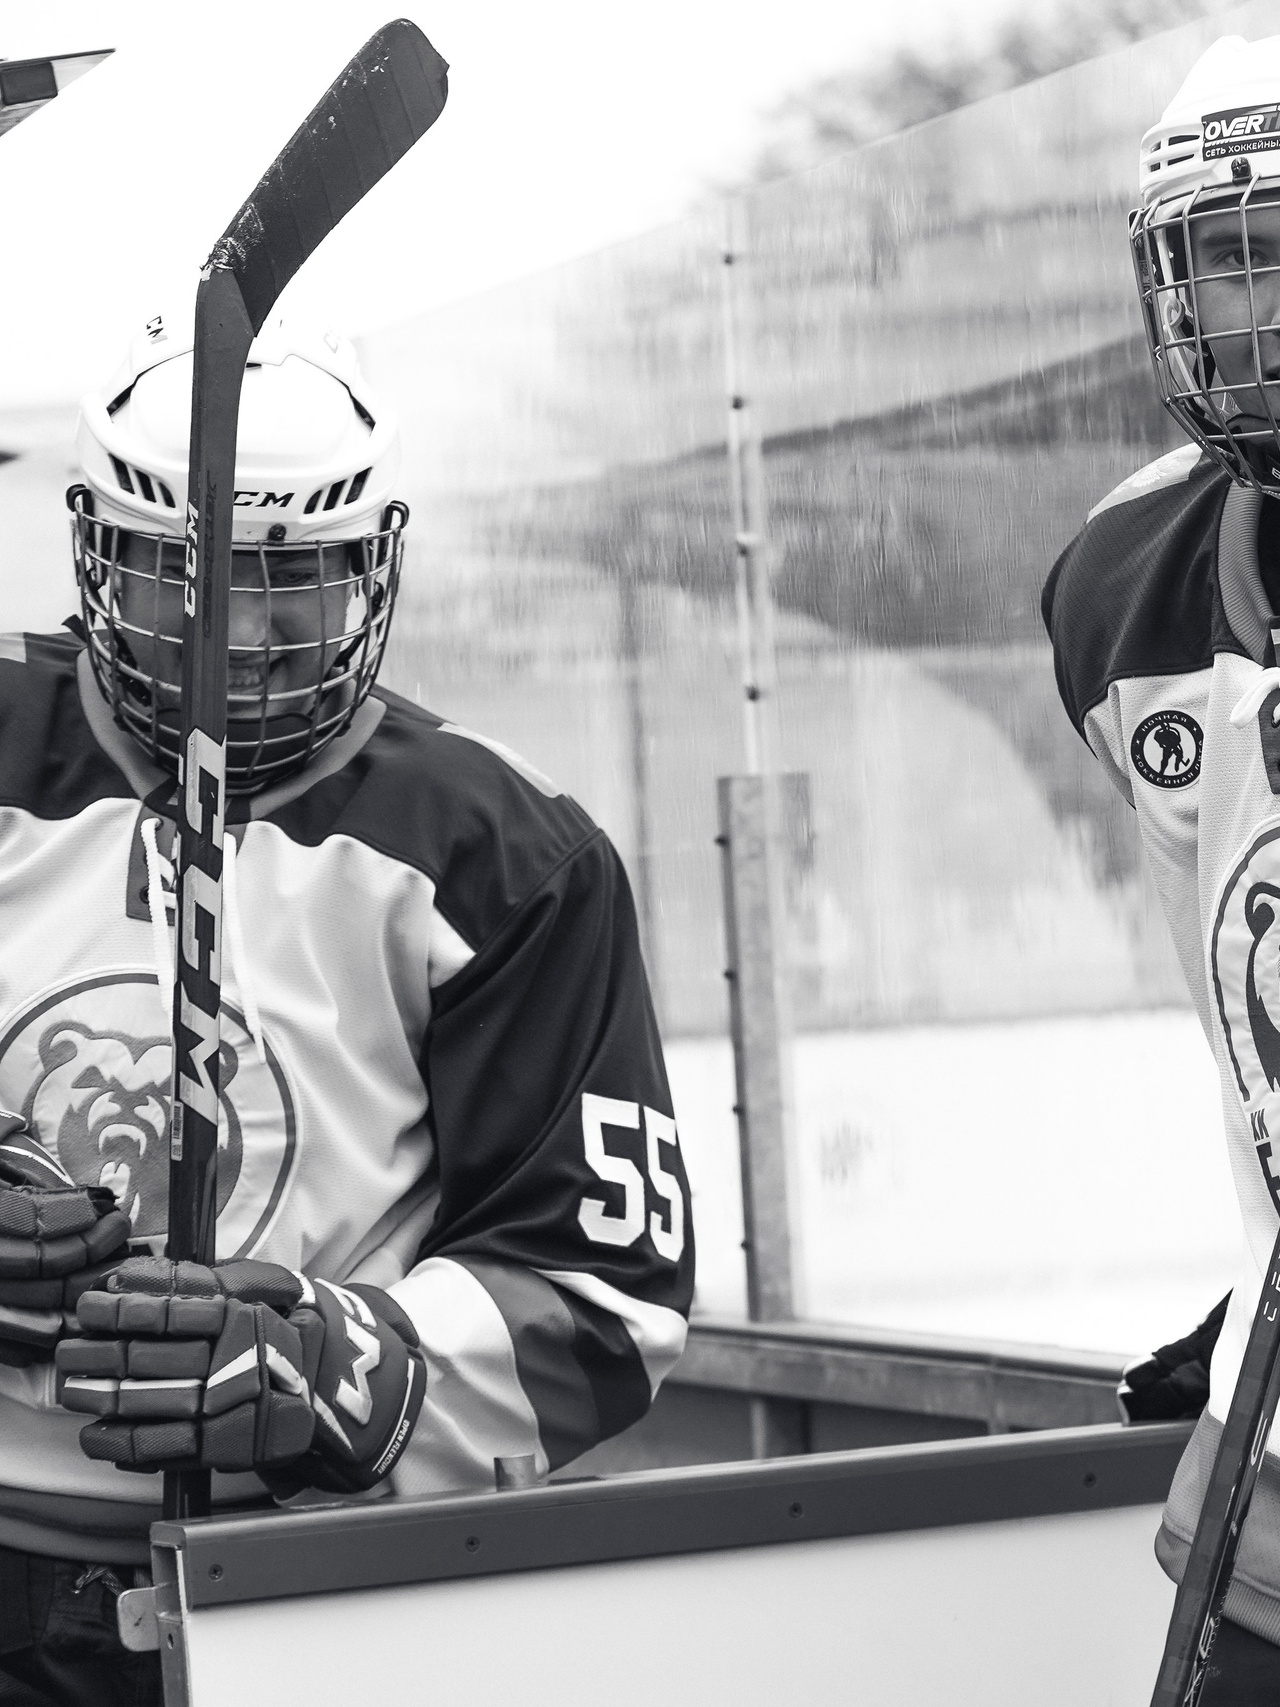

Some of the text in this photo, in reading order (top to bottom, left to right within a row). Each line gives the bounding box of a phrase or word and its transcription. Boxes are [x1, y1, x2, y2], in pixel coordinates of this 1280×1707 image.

[1205, 148, 1227, 158] СЕТЬ
[233, 490, 295, 508] CM
[184, 501, 199, 618] CCM
[1141, 714, 1188, 732] НОЧНАЯ
[181, 727, 227, 1128] CCM
[577, 1092, 685, 1263] 55
